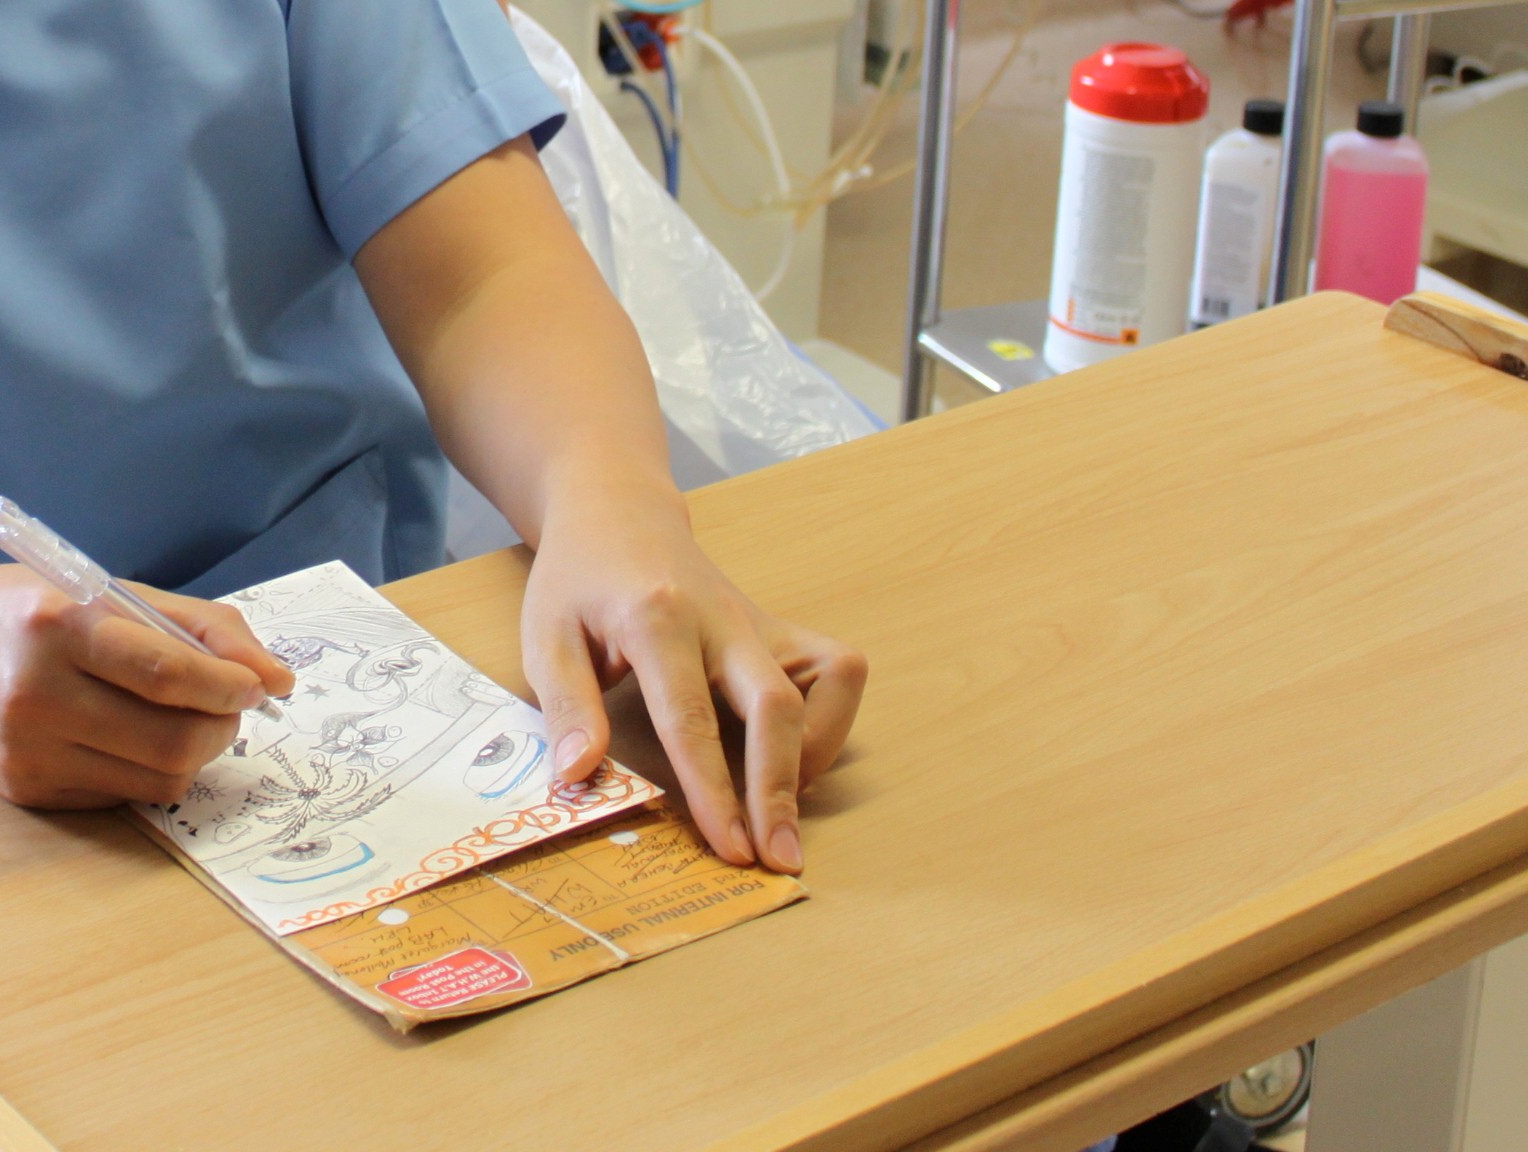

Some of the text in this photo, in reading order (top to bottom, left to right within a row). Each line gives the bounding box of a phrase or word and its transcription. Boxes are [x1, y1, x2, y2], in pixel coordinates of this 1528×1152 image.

[625, 869, 751, 916] 2nd EDITION
[549, 879, 766, 962] FOR INTERNAL USE ONLY
[408, 925, 448, 946] LAB
[398, 960, 487, 997] in the Post Room
[416, 964, 455, 983] Today!
[470, 970, 509, 991] PLEASE
[479, 964, 501, 976] the
[407, 987, 439, 1002] Inbox
[431, 986, 469, 1003] Return
